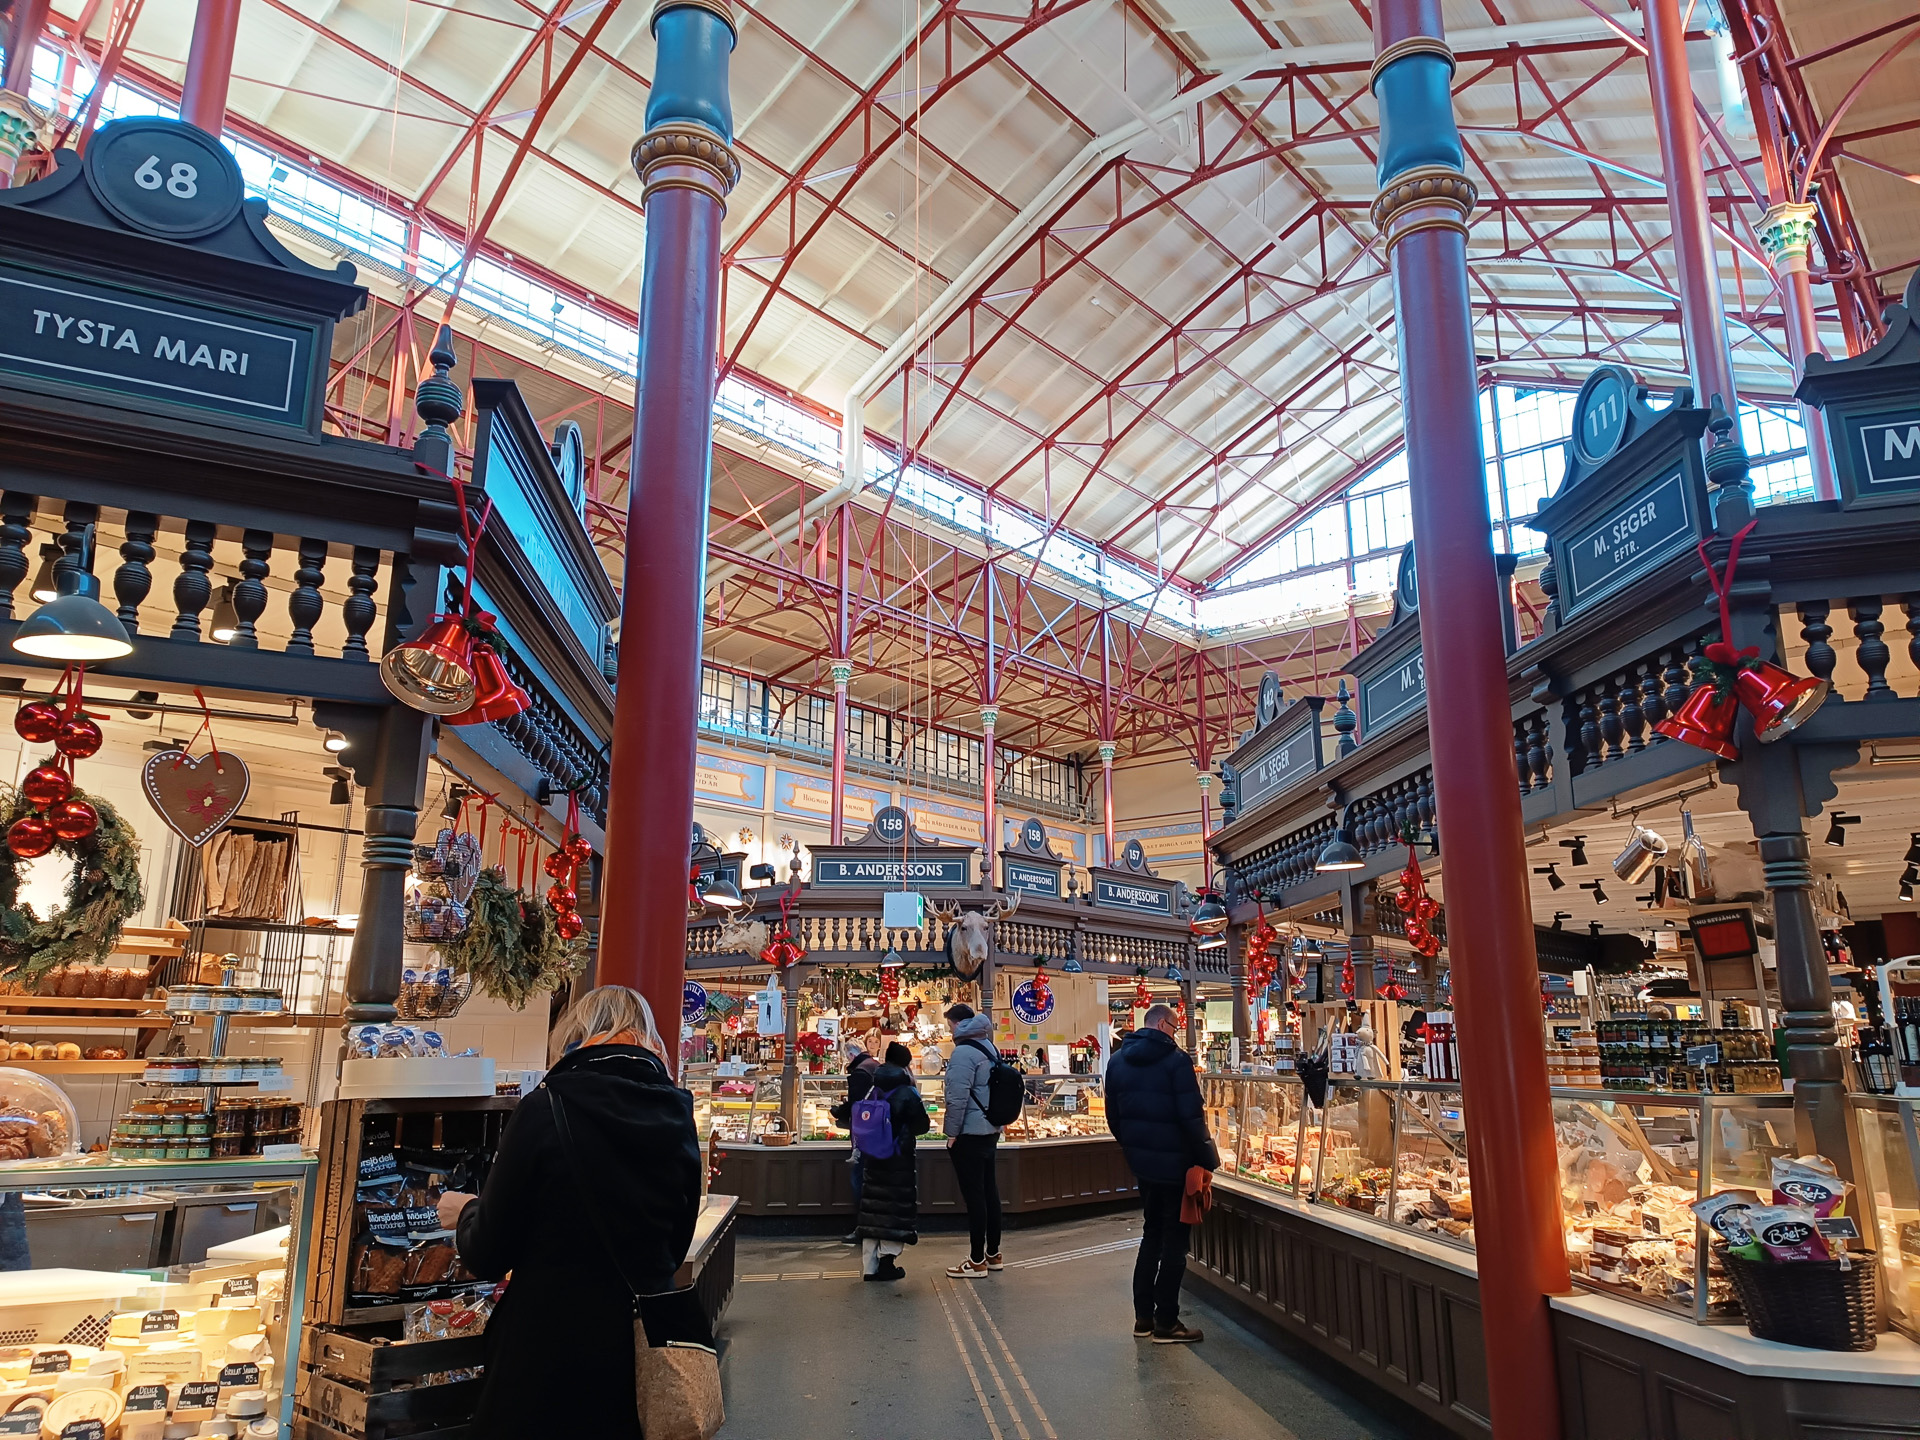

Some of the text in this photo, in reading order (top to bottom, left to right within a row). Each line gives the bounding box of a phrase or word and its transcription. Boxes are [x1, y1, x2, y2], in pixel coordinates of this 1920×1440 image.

[134, 155, 198, 200] 68
[32, 309, 249, 376] TYSTA MARI
[1588, 394, 1618, 437] 111
[1594, 501, 1657, 558] M. SEGER
[1614, 540, 1640, 564] EFTR.
[1401, 665, 1415, 692] M.
[1263, 687, 1275, 710] 142
[1268, 750, 1290, 777] SEGER
[881, 818, 903, 831] 158
[691, 832, 699, 843] 3
[1027, 829, 1041, 842] 158
[1129, 849, 1140, 861] 157
[839, 864, 943, 877] B. ANDERSSONS
[1012, 872, 1053, 886] B. ANDERSSONS
[1108, 886, 1159, 904] B. ANDERSSONS
[378, 1153, 394, 1163] deli
[1785, 1183, 1827, 1202] Brets
[368, 1212, 403, 1223] Mörsjö deli
[406, 1210, 436, 1222] Mörsjö
[1767, 1226, 1809, 1245] Brets
